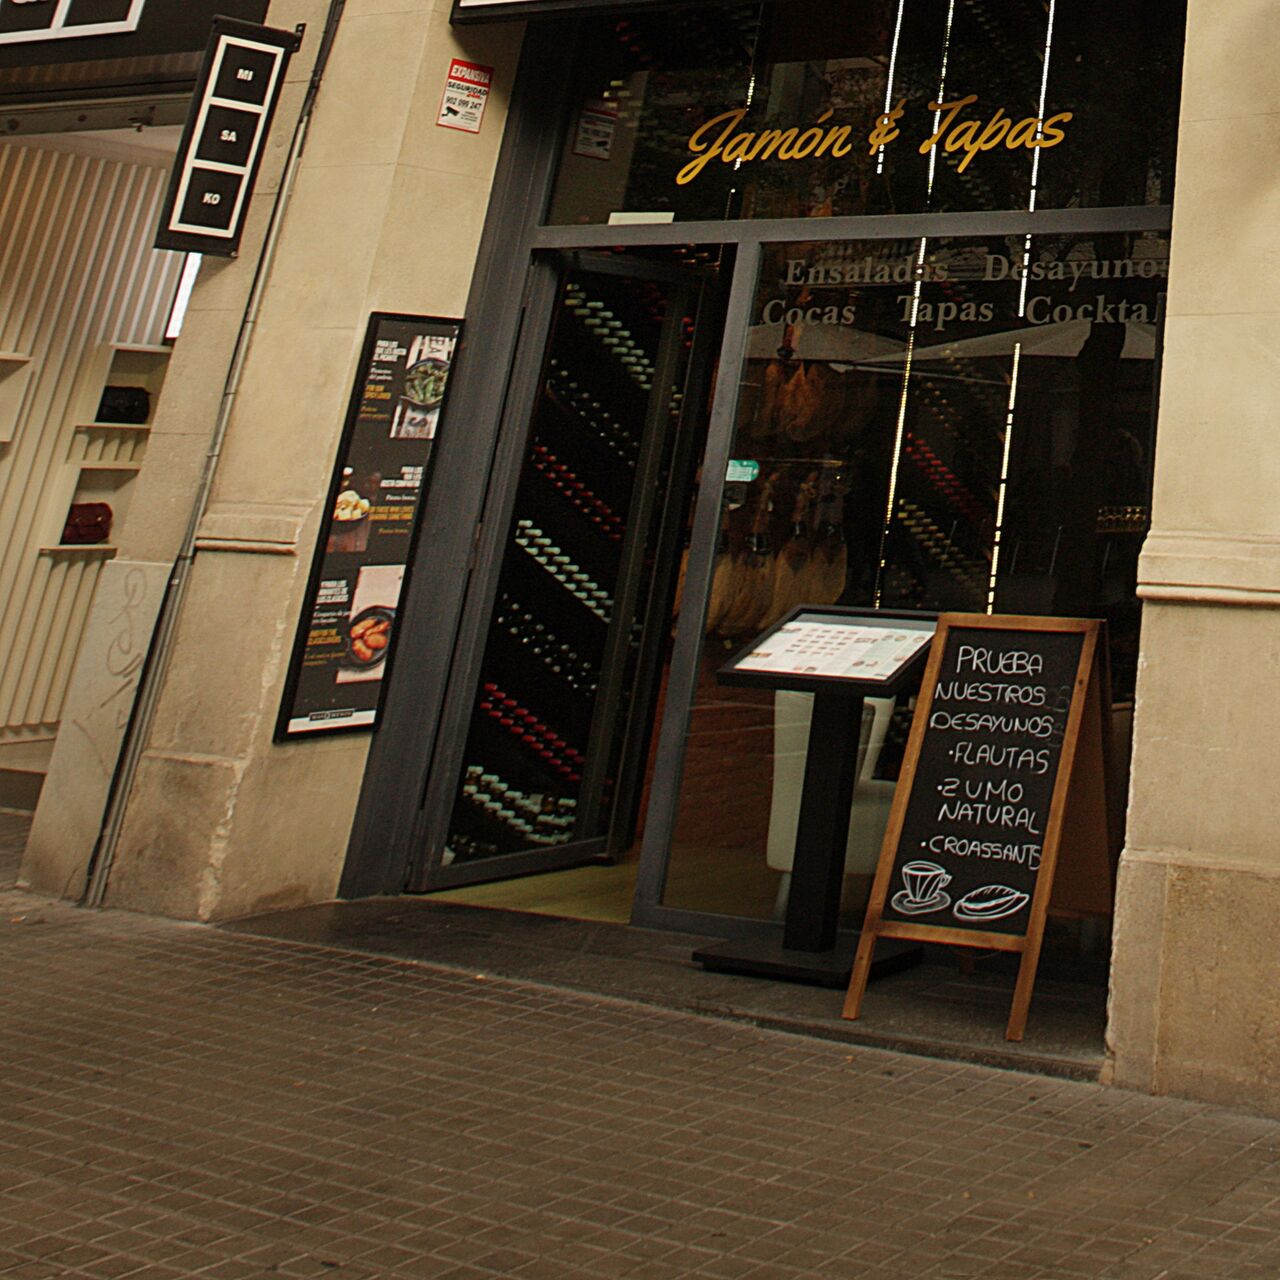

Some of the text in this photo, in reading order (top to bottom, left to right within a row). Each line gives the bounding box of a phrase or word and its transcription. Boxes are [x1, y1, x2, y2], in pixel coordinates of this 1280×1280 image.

[236, 68, 253, 81] MI
[447, 81, 489, 96] SEGURIDAD
[220, 129, 236, 142] SA
[676, 107, 852, 184] Jamón
[869, 99, 905, 155] &
[919, 94, 1073, 174] Tapas
[203, 192, 220, 205] KO
[784, 254, 949, 286] Ensaladas
[762, 298, 856, 326] Cocas
[896, 295, 994, 332] Tapas
[956, 645, 1043, 676] PRUEBA
[934, 681, 1046, 706] NUESTROS
[930, 711, 1054, 737] DESAYUNOS
[954, 742, 1050, 774] FLAUTAS
[937, 801, 1039, 834] NATURAL
